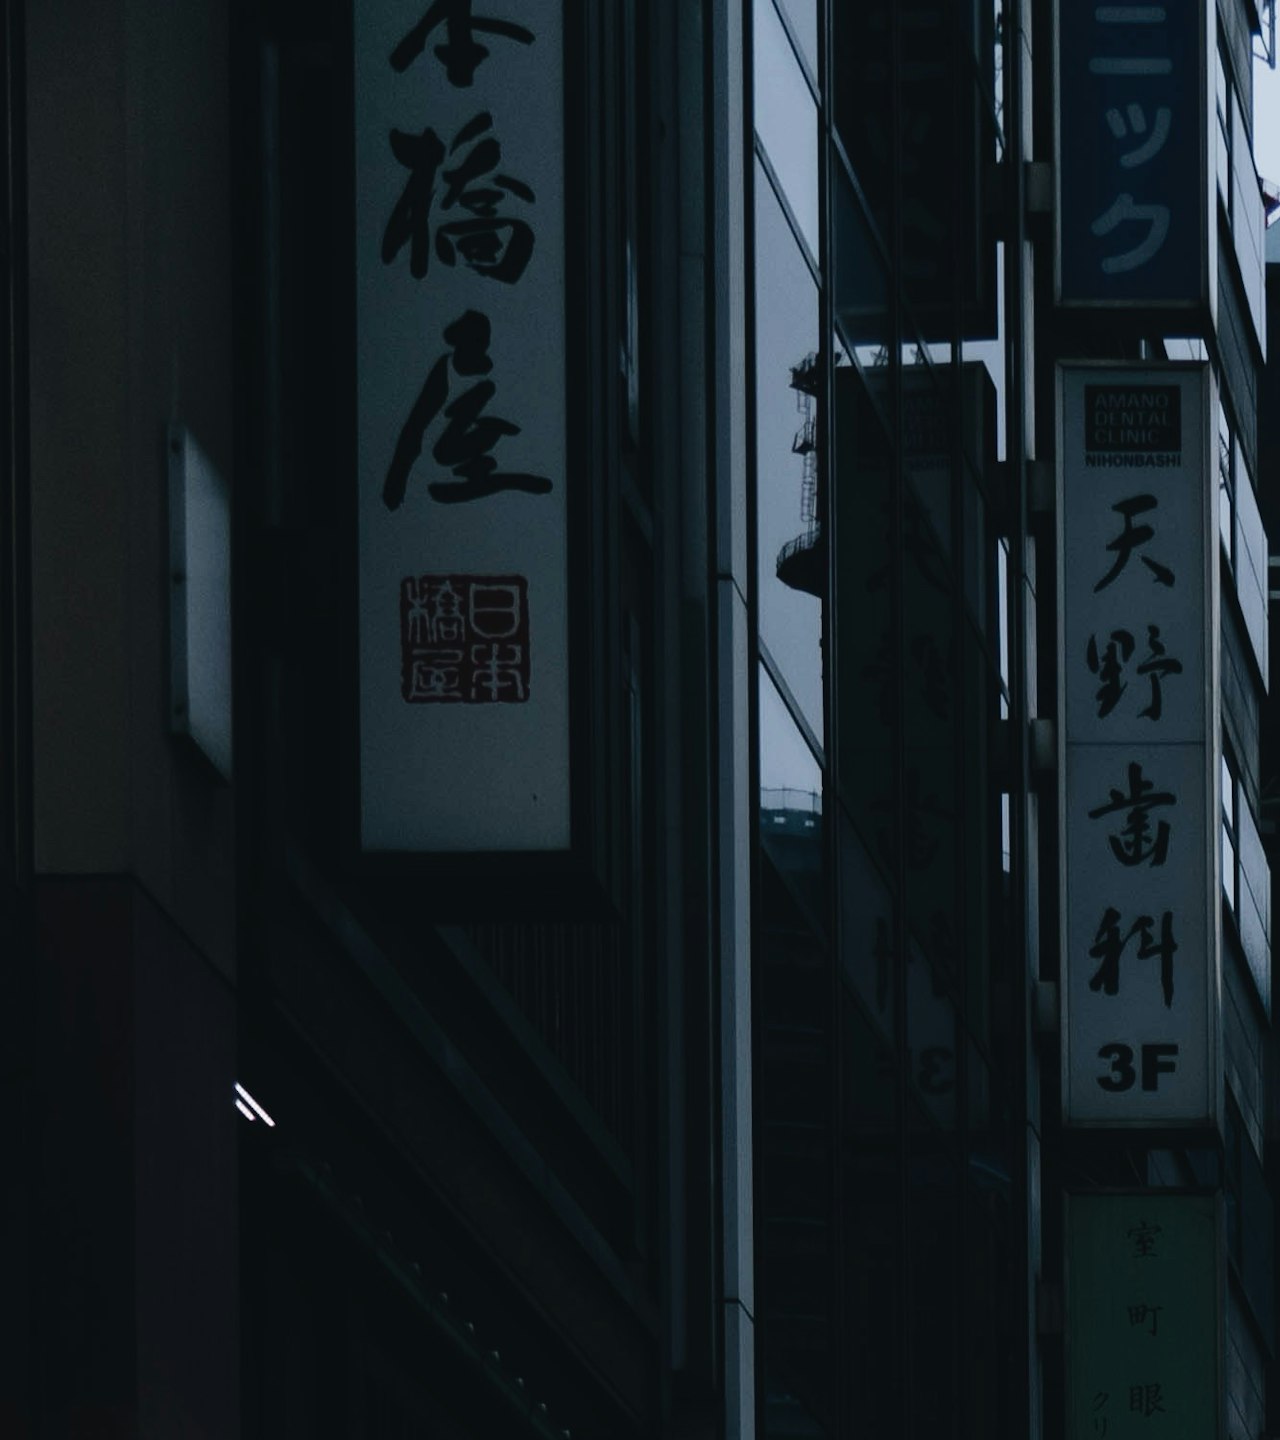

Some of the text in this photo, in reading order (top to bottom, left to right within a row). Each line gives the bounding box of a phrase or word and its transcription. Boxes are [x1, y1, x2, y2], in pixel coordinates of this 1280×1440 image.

[1095, 392, 1169, 409] AMANO
[1095, 410, 1170, 427] DENTAL
[1095, 428, 1160, 445] CLINIC
[1085, 454, 1181, 468] NIHONBASHI
[1086, 494, 1183, 1010] 天野歯科
[1096, 1043, 1180, 1092] 3F
